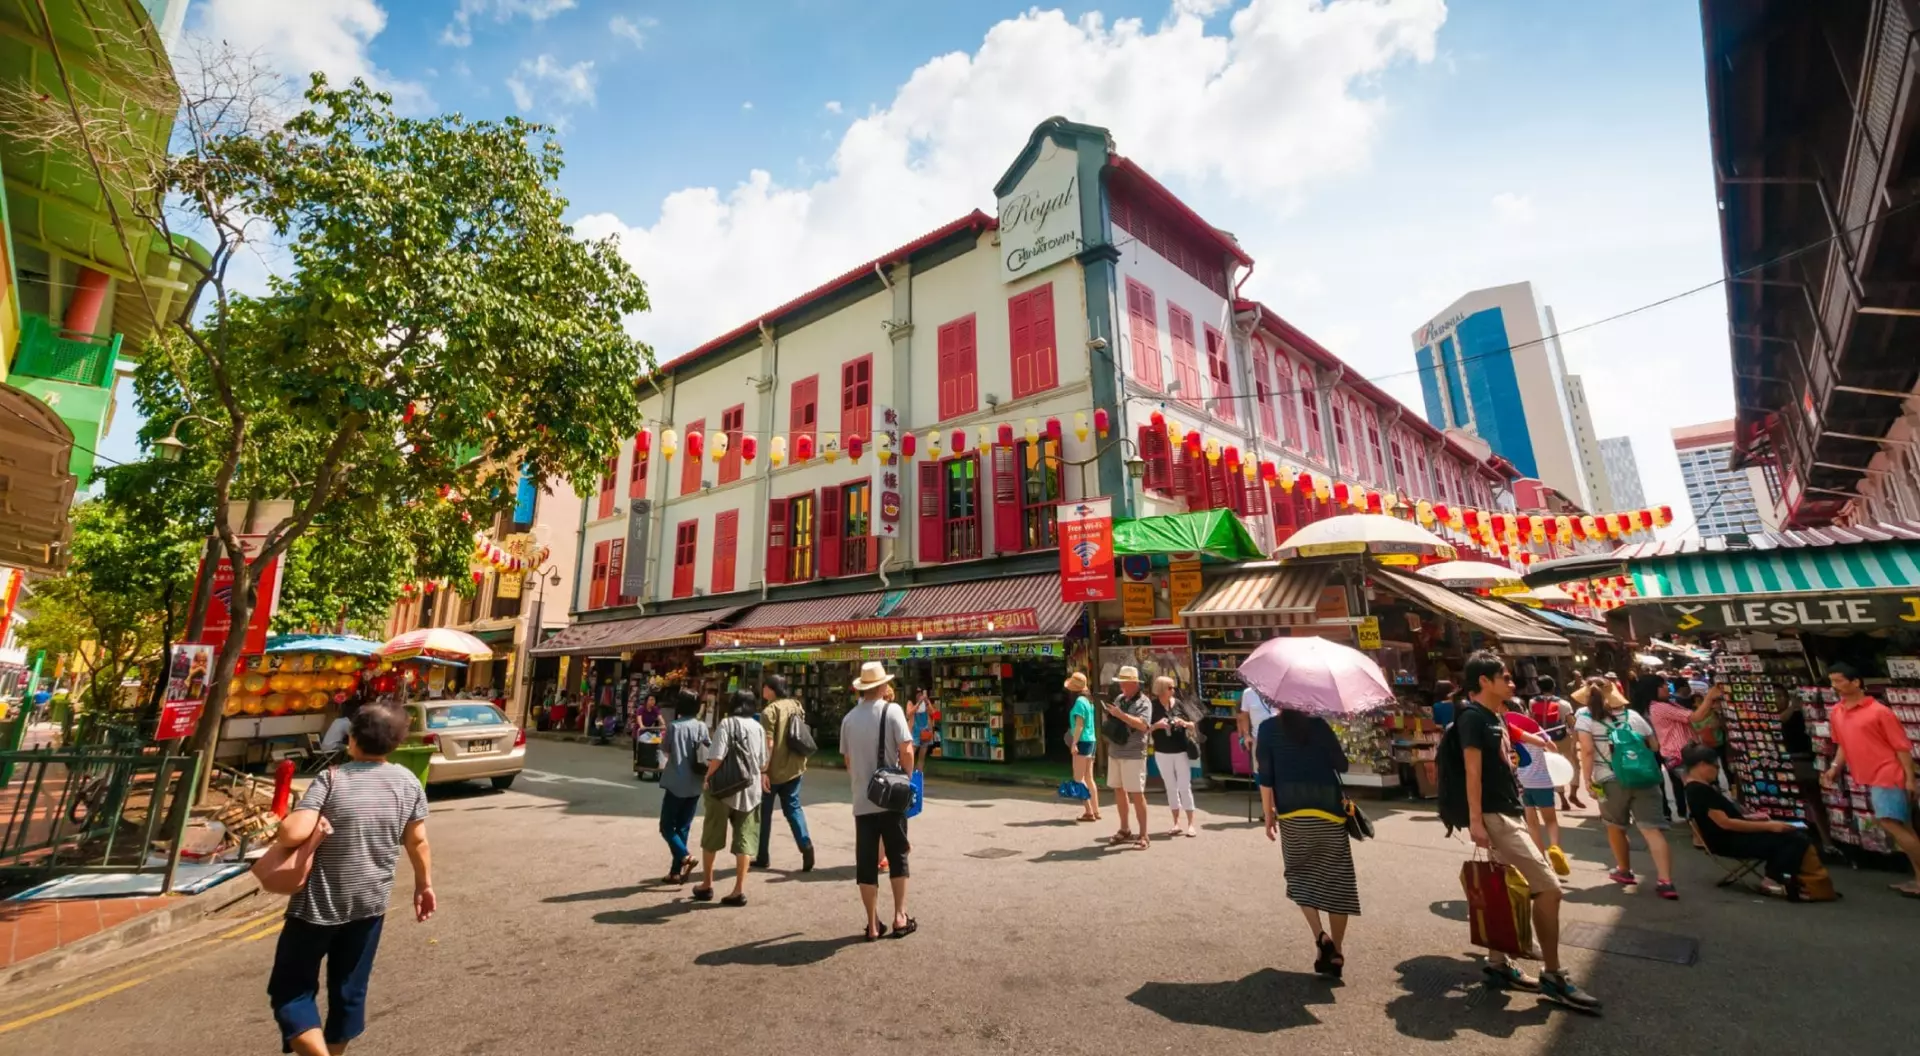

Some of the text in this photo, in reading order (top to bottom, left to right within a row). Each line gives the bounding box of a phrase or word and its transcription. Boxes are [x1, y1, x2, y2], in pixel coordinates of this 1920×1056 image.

[1001, 176, 1075, 234] Royal
[1006, 230, 1076, 272] CHINATOWN
[1721, 599, 1876, 626] LESLIE
